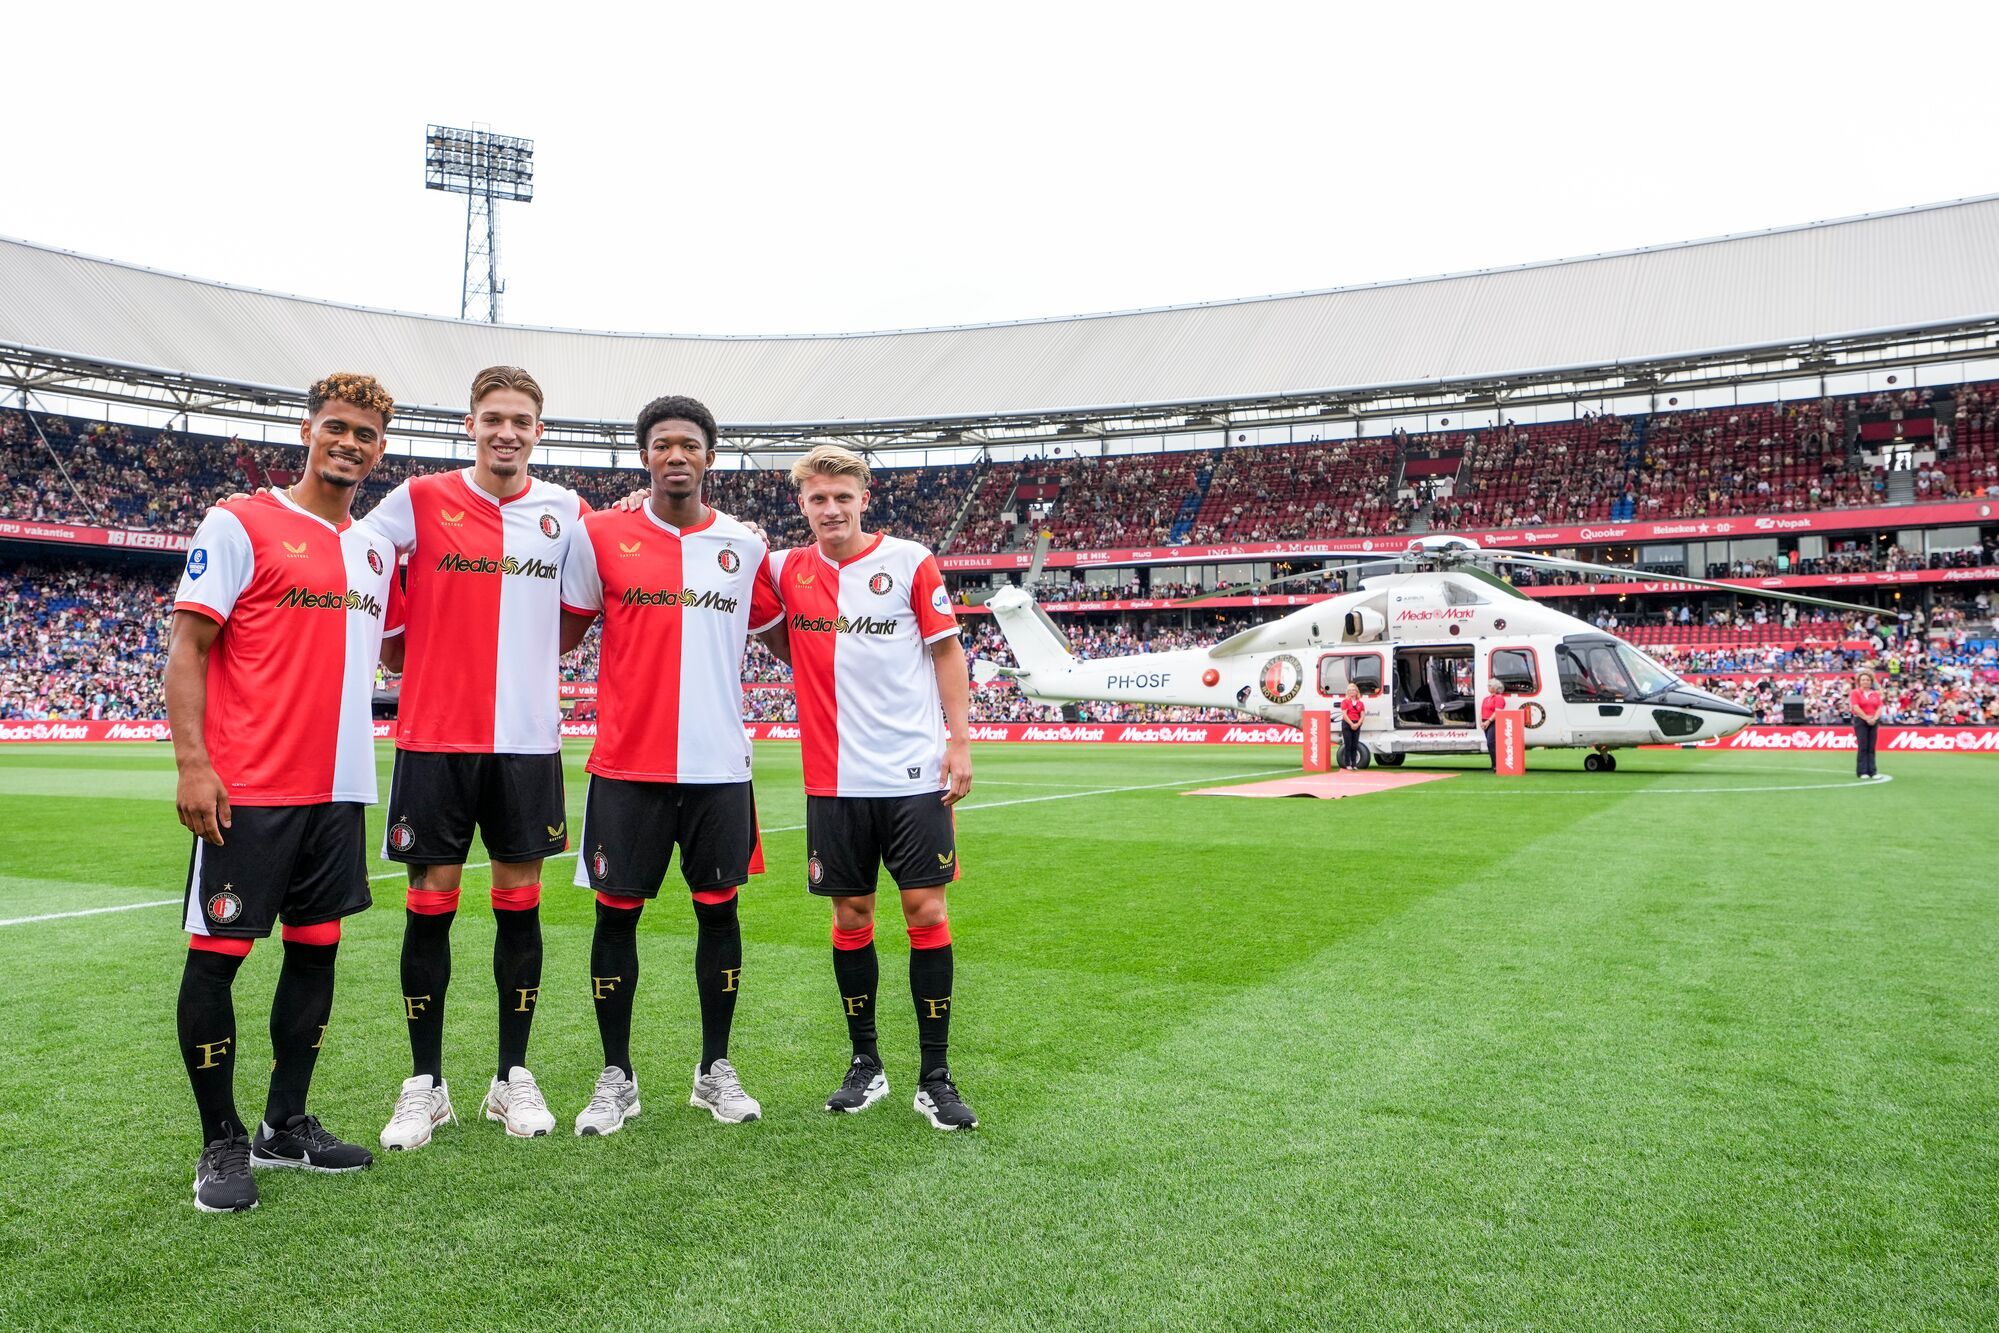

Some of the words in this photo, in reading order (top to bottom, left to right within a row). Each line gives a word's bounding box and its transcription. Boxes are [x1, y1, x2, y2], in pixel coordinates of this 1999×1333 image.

[24, 527, 75, 538] vakanties
[1653, 525, 1696, 534] Heineken
[1776, 518, 1811, 529] Vopak
[107, 530, 125, 545] 16
[126, 532, 166, 549] KEER
[1580, 528, 1627, 540] Quooker
[435, 552, 500, 575] Media
[515, 558, 557, 580] Markt
[943, 558, 992, 567] RIVERDALE
[274, 587, 342, 609] Media
[620, 587, 678, 607] Media
[696, 590, 738, 614] Markt
[1396, 609, 1433, 621] Media
[1441, 608, 1475, 619] Markt
[790, 613, 833, 633] Media
[848, 616, 897, 635] Markt
[1107, 673, 1171, 689] PH-OSF
[43, 724, 89, 740] Markt
[105, 723, 152, 739] Media
[976, 727, 1008, 740] Markt
[1021, 727, 1057, 740] Media
[1069, 727, 1104, 740] Markt
[1118, 727, 1160, 742] Media
[1170, 727, 1208, 742] Markt
[1222, 728, 1267, 742] Media
[1730, 730, 1792, 747] Media
[1808, 731, 1858, 748] Mark
[1888, 731, 1956, 749] Media
[592, 976, 622, 999] F
[721, 967, 742, 992] F
[403, 994, 431, 1020] F
[514, 987, 539, 1012] F
[843, 994, 868, 1016] F
[923, 996, 951, 1019] F
[196, 1037, 231, 1070] F
